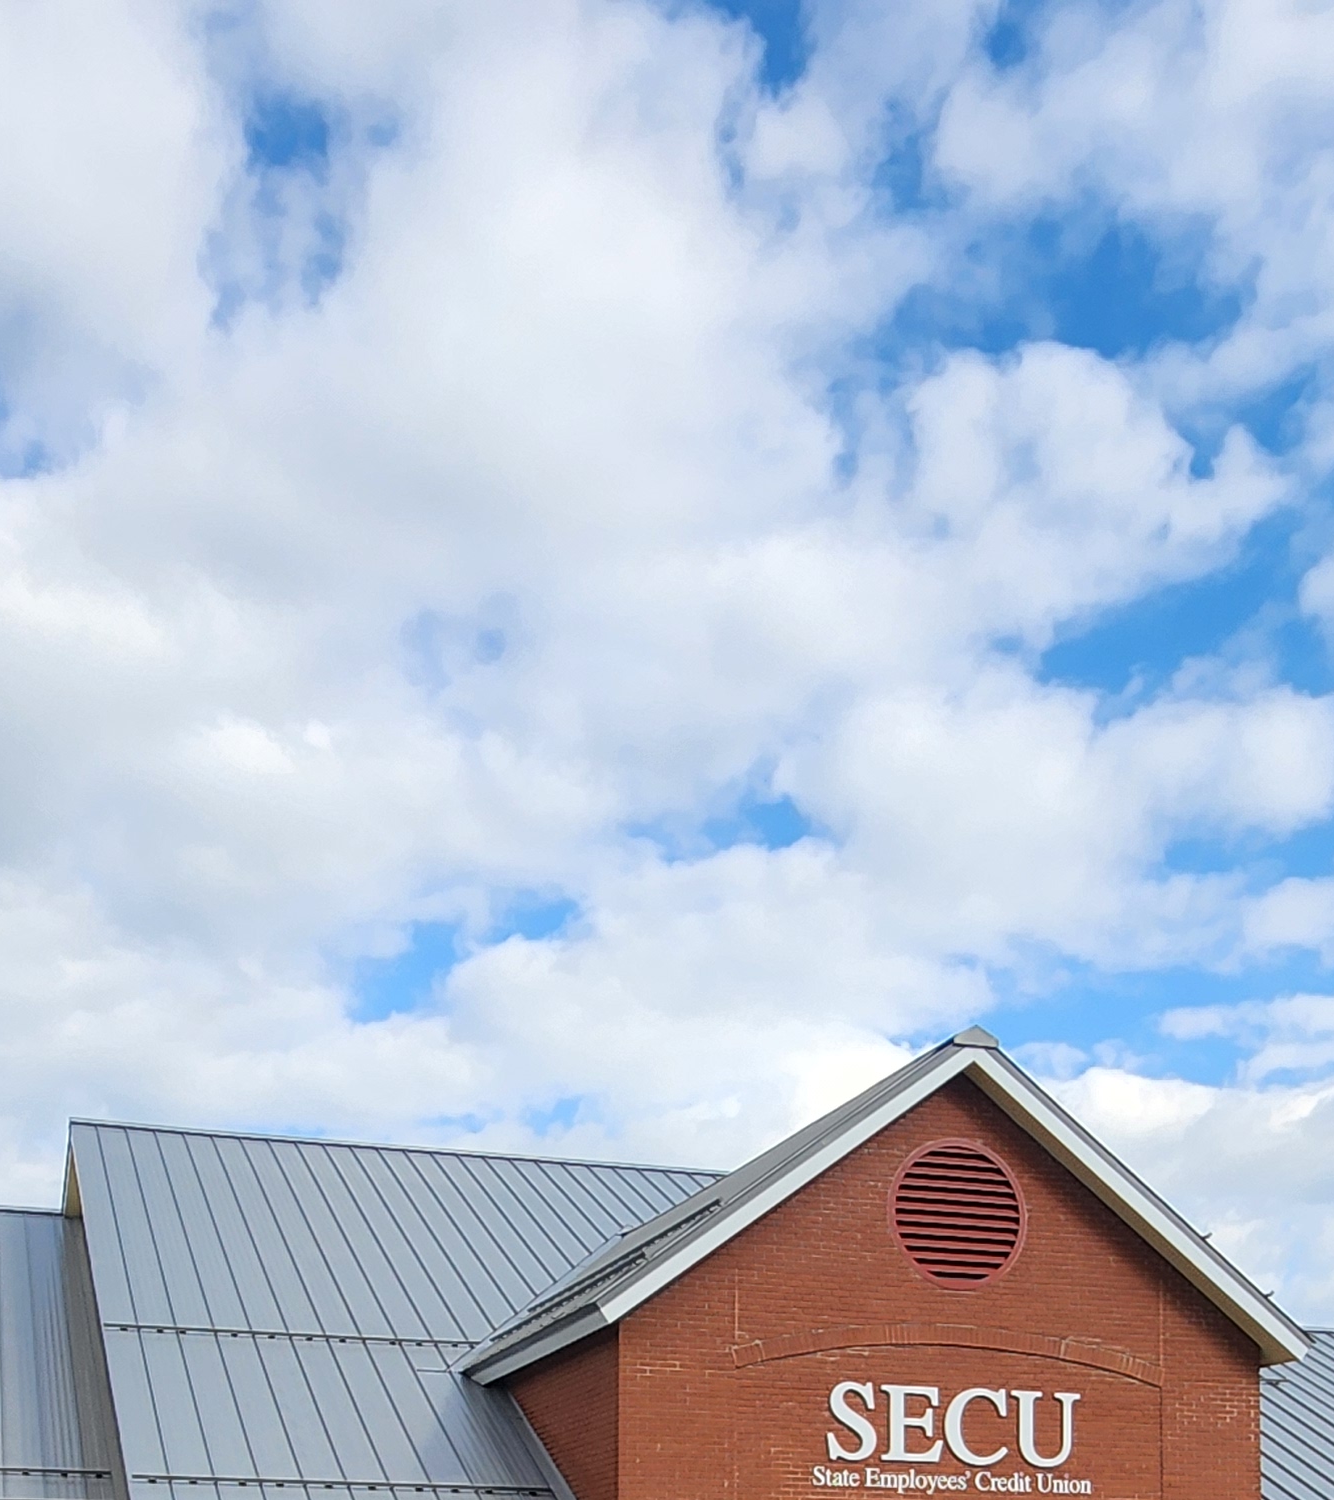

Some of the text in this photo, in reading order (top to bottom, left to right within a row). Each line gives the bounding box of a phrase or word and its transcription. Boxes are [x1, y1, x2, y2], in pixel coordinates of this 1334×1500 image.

[825, 1380, 1081, 1468] SECU
[812, 1466, 861, 1487] State
[974, 1470, 1033, 1493] Credit
[1036, 1473, 1092, 1495] Union
